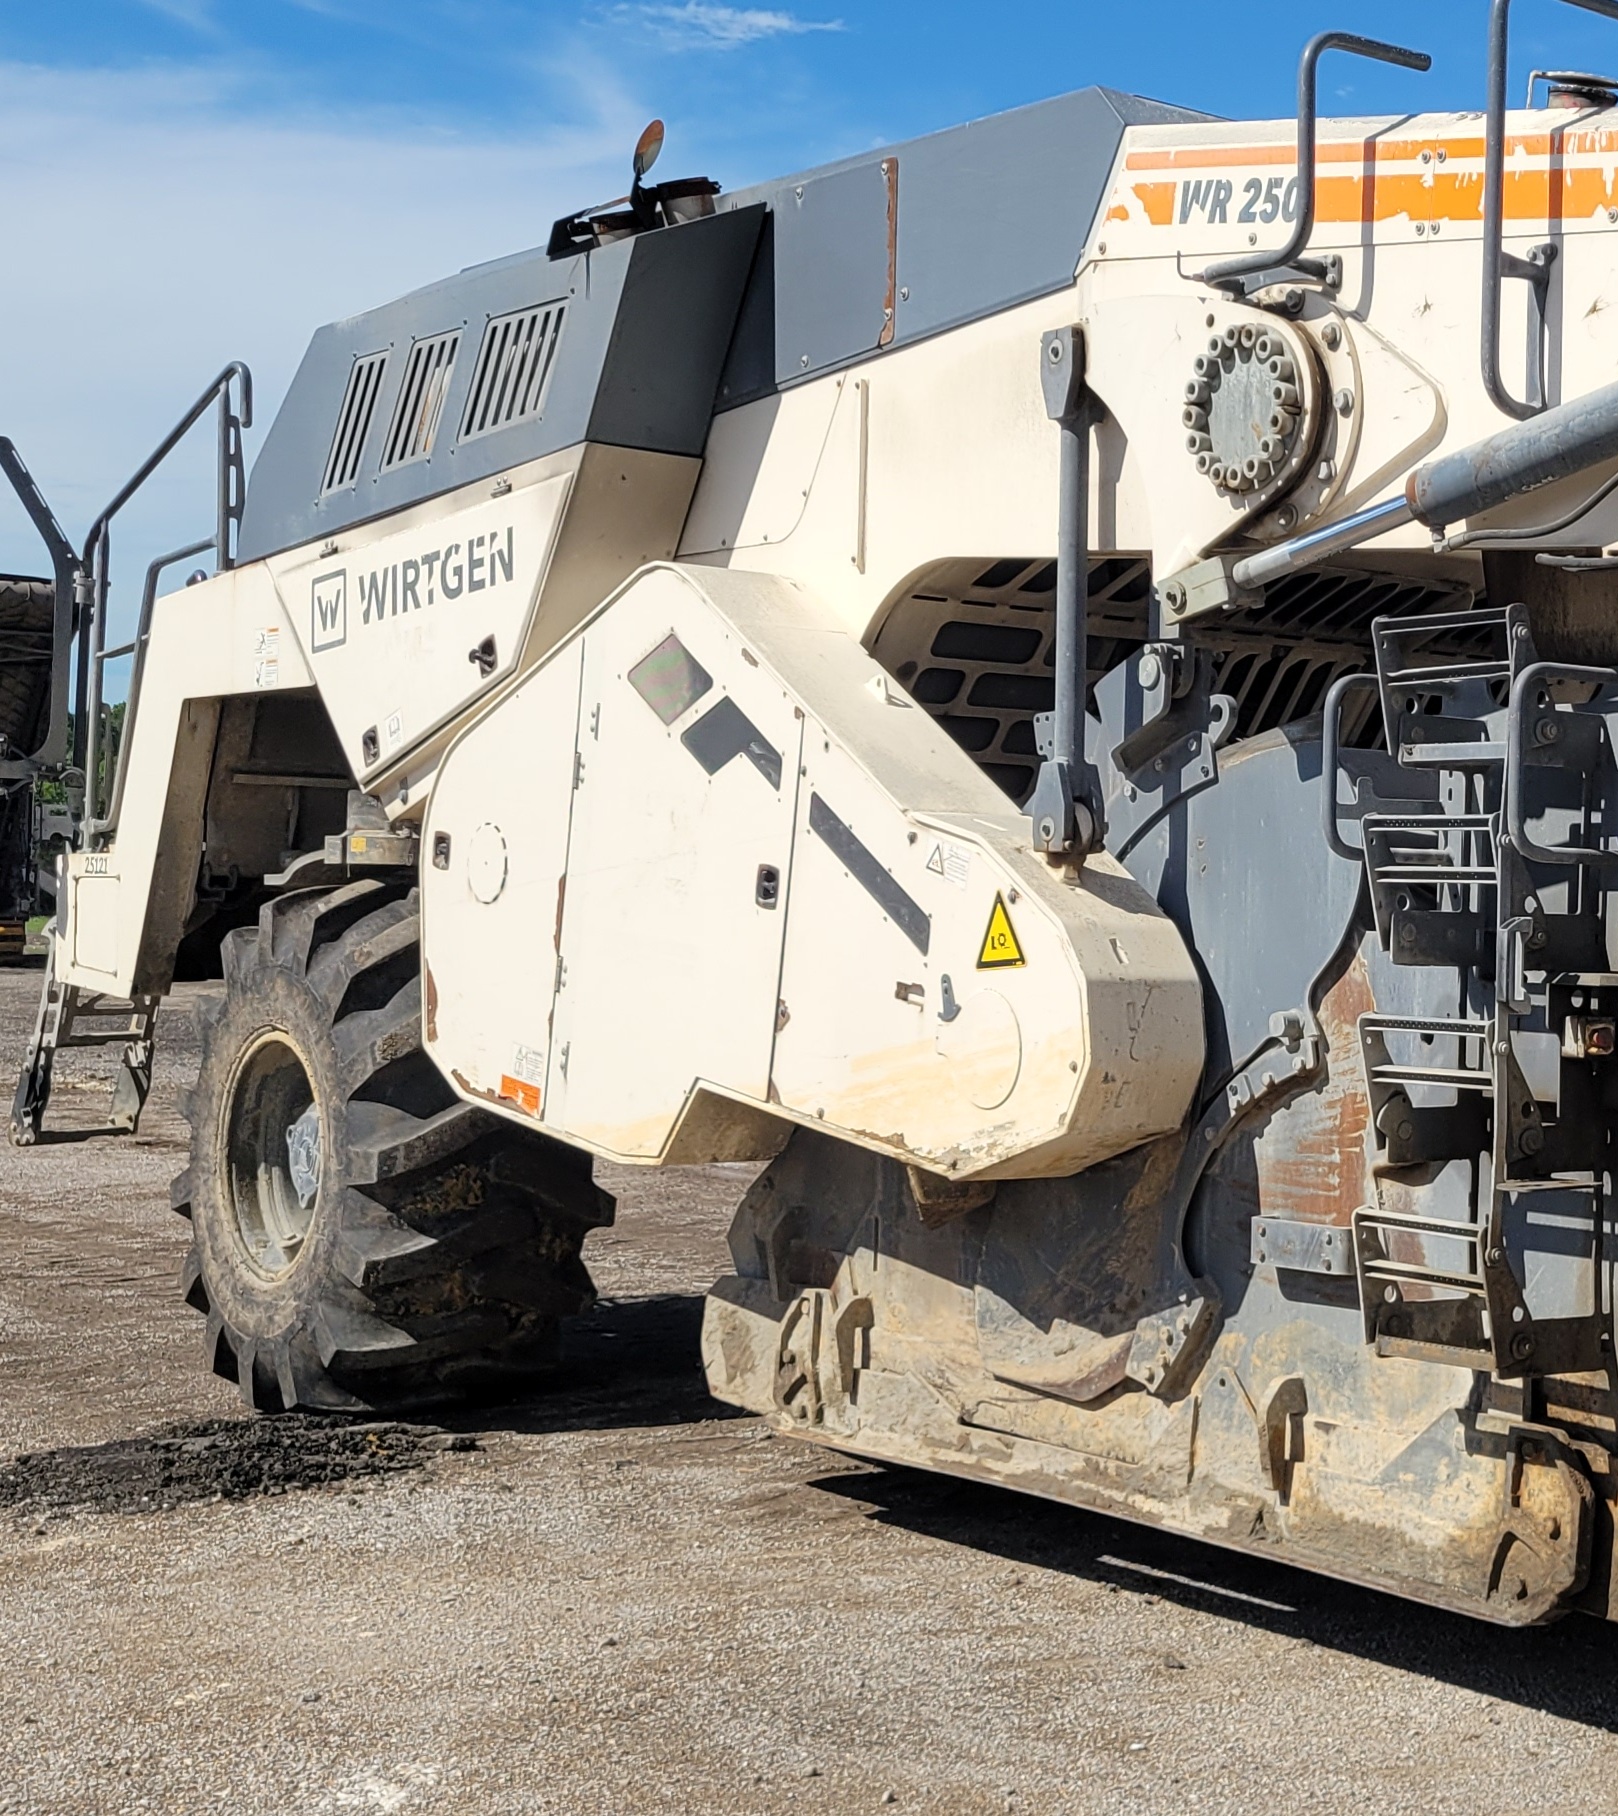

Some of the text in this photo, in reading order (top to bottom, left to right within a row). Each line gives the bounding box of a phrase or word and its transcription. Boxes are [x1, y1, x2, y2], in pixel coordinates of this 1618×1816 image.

[1179, 176, 1300, 225] WR 250
[358, 525, 514, 626] WIRTGEN
[84, 856, 109, 875] 25121
